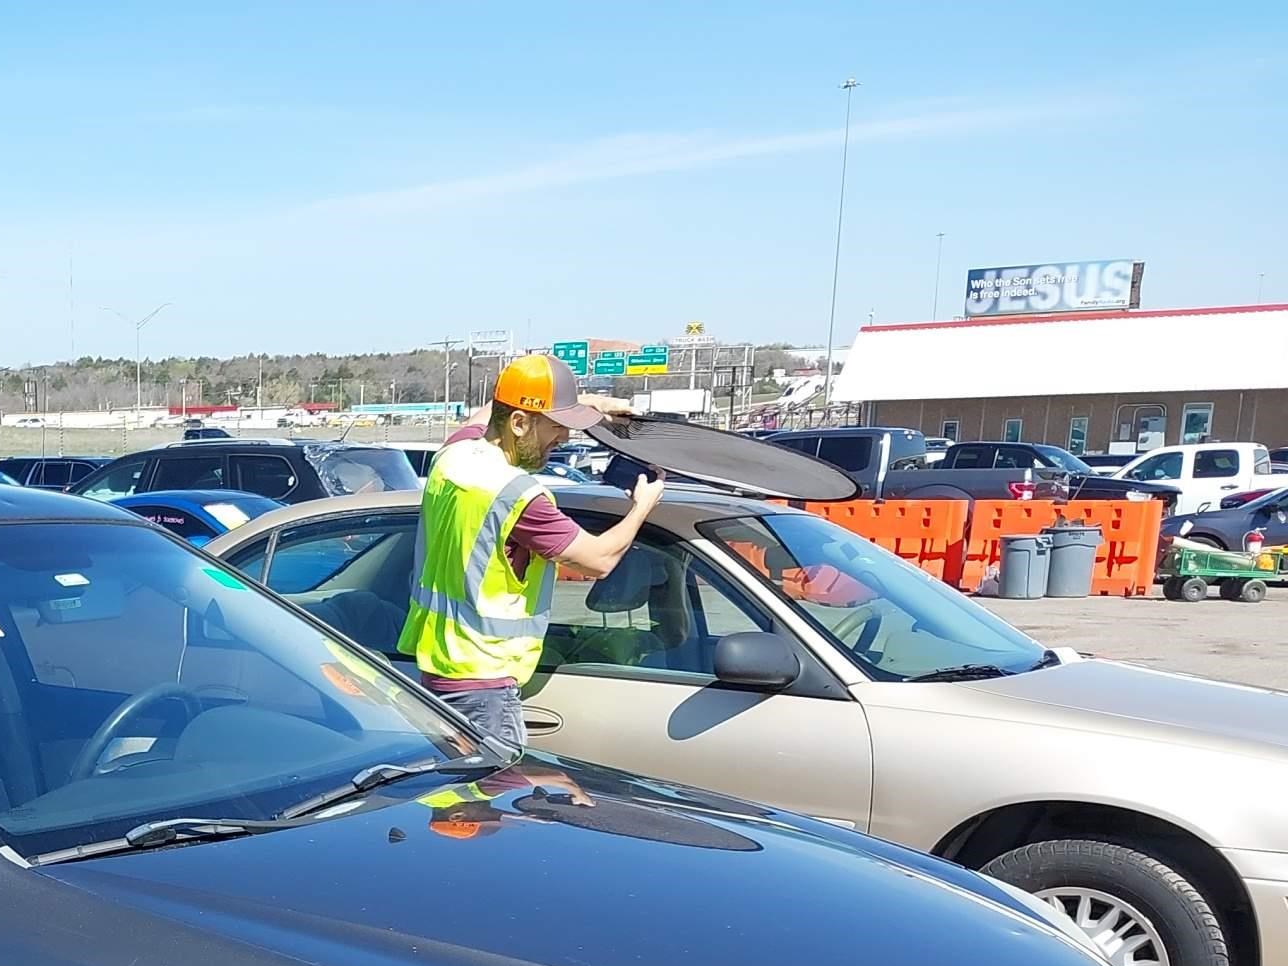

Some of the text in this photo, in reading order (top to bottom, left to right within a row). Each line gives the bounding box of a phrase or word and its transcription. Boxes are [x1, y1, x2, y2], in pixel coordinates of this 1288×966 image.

[966, 261, 1130, 313] JESUS
[970, 274, 1078, 289] Who the Son sets free
[980, 289, 1000, 298] free
[1001, 287, 1038, 297] indeed.
[519, 396, 546, 409] EATON
